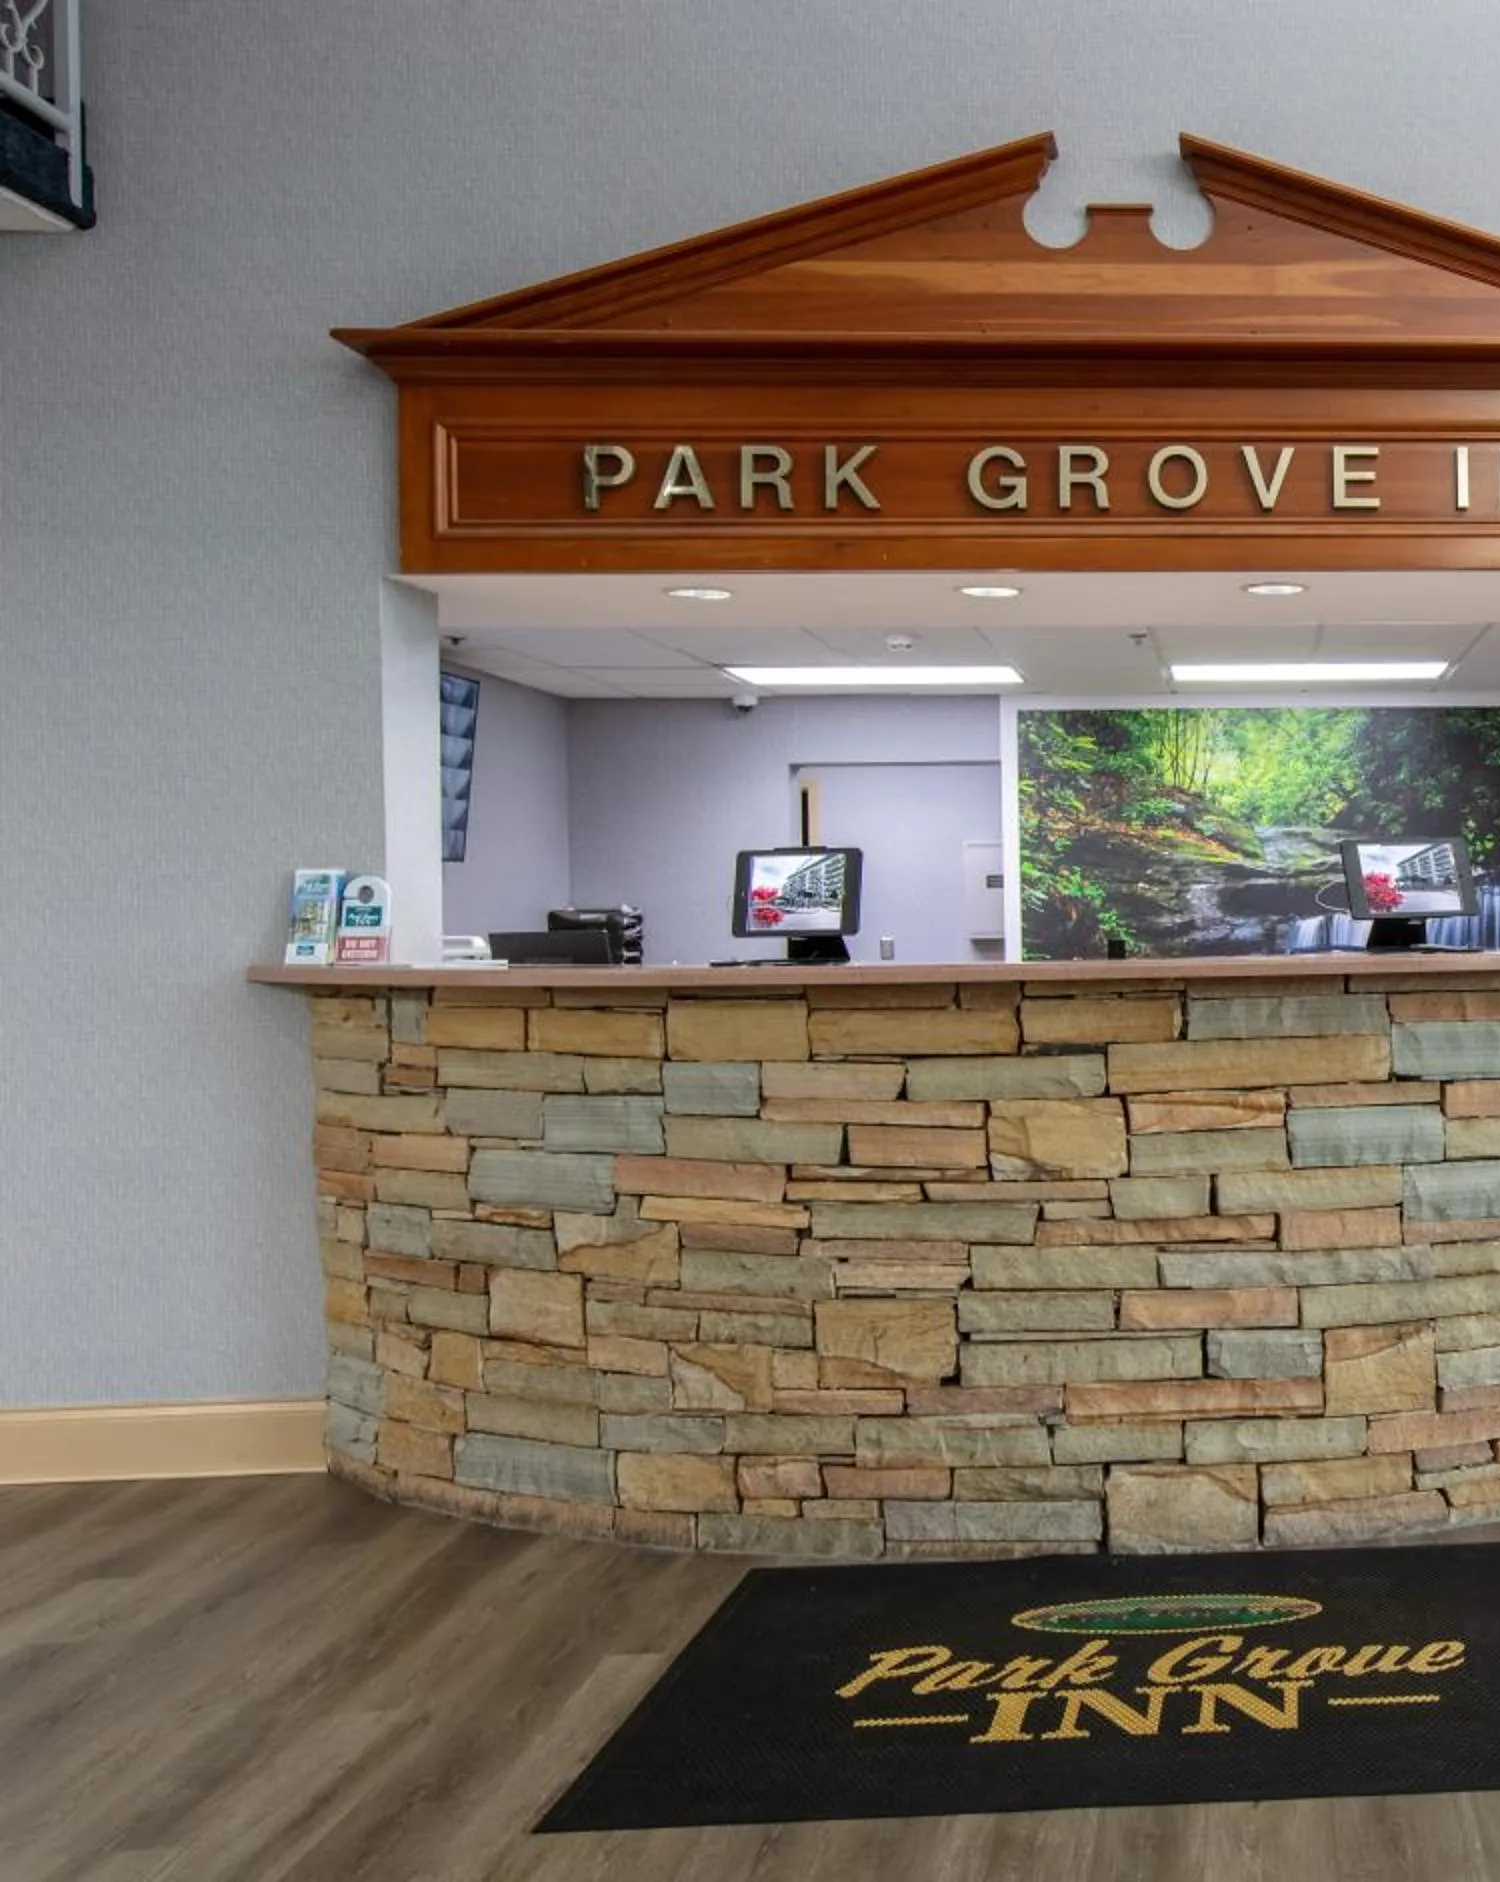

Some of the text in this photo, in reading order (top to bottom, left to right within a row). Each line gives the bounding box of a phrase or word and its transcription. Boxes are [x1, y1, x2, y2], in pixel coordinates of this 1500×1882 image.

[583, 444, 881, 510] PARK
[967, 444, 1381, 510] GROVE
[835, 1633, 1466, 1699] Park Grove
[967, 1679, 1315, 1745] INN
